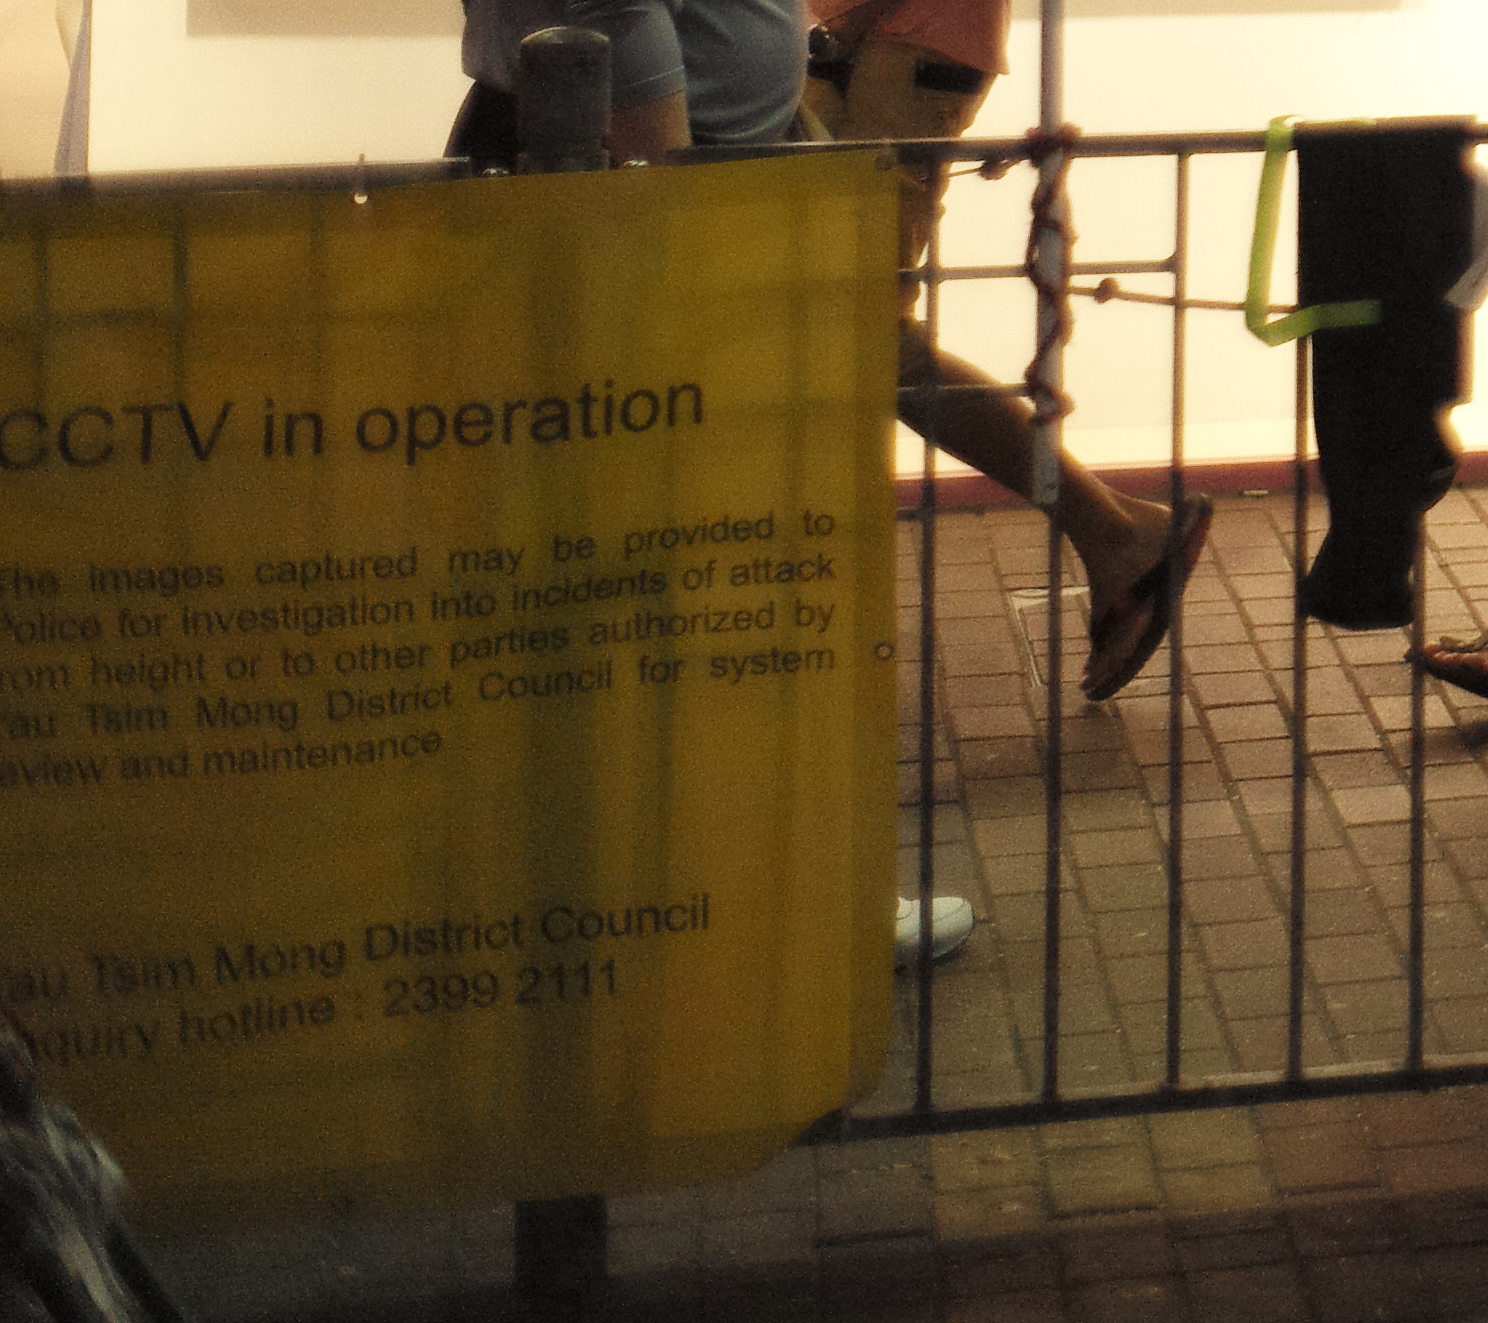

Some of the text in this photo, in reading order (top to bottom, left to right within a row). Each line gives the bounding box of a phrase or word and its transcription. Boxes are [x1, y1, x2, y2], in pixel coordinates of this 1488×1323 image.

[0, 379, 705, 472] CCTV in operation
[88, 563, 225, 598] images
[254, 546, 418, 589] captured
[447, 545, 526, 577] may
[552, 535, 596, 565] be
[624, 510, 776, 560] provided
[802, 510, 837, 538] to
[117, 608, 167, 639] for
[182, 596, 415, 637] investigation
[431, 590, 497, 620] into
[512, 567, 669, 613] incidents
[681, 560, 716, 593] of
[730, 552, 837, 587] attack
[90, 652, 206, 693] height
[224, 653, 262, 680] or
[282, 648, 317, 678] to
[334, 642, 431, 675] other
[449, 622, 571, 669] parties
[587, 602, 776, 647] authorized
[793, 598, 836, 635] by
[0, 645, 837, 740] au Tsim Mong District Council for system
[119, 748, 190, 781] and
[203, 729, 443, 776] maintenance
[215, 938, 347, 986] Mong
[363, 911, 524, 962] District
[539, 893, 712, 946] Council
[179, 992, 336, 1045] hotline
[383, 968, 499, 1018] 2399
[516, 958, 619, 1006] 2111
